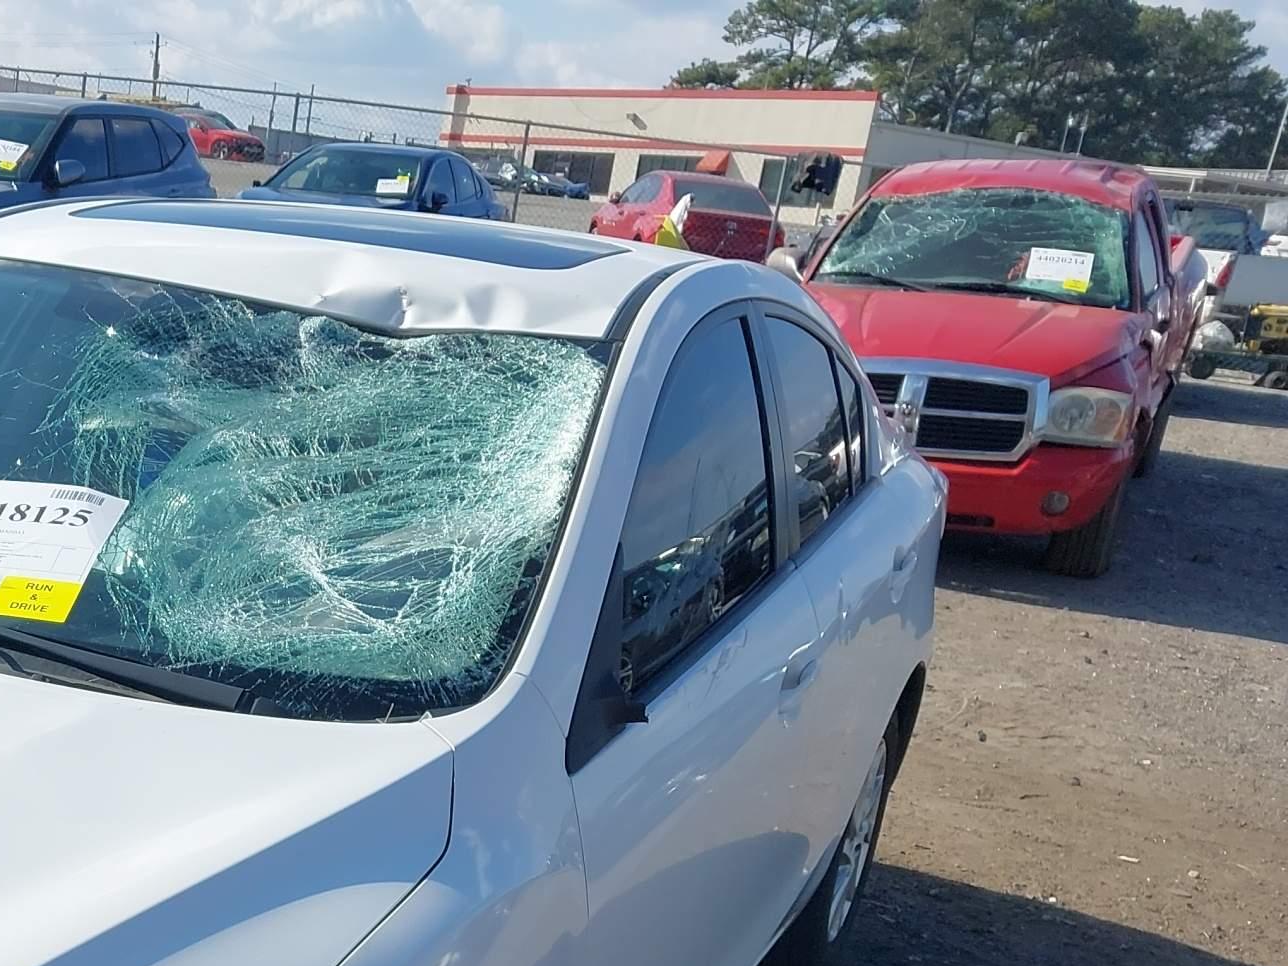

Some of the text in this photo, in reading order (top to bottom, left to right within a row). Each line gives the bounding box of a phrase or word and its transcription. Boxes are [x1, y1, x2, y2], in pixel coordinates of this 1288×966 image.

[25, 581, 54, 593] RUN
[29, 593, 39, 601] &
[9, 602, 49, 613] DRIVE
